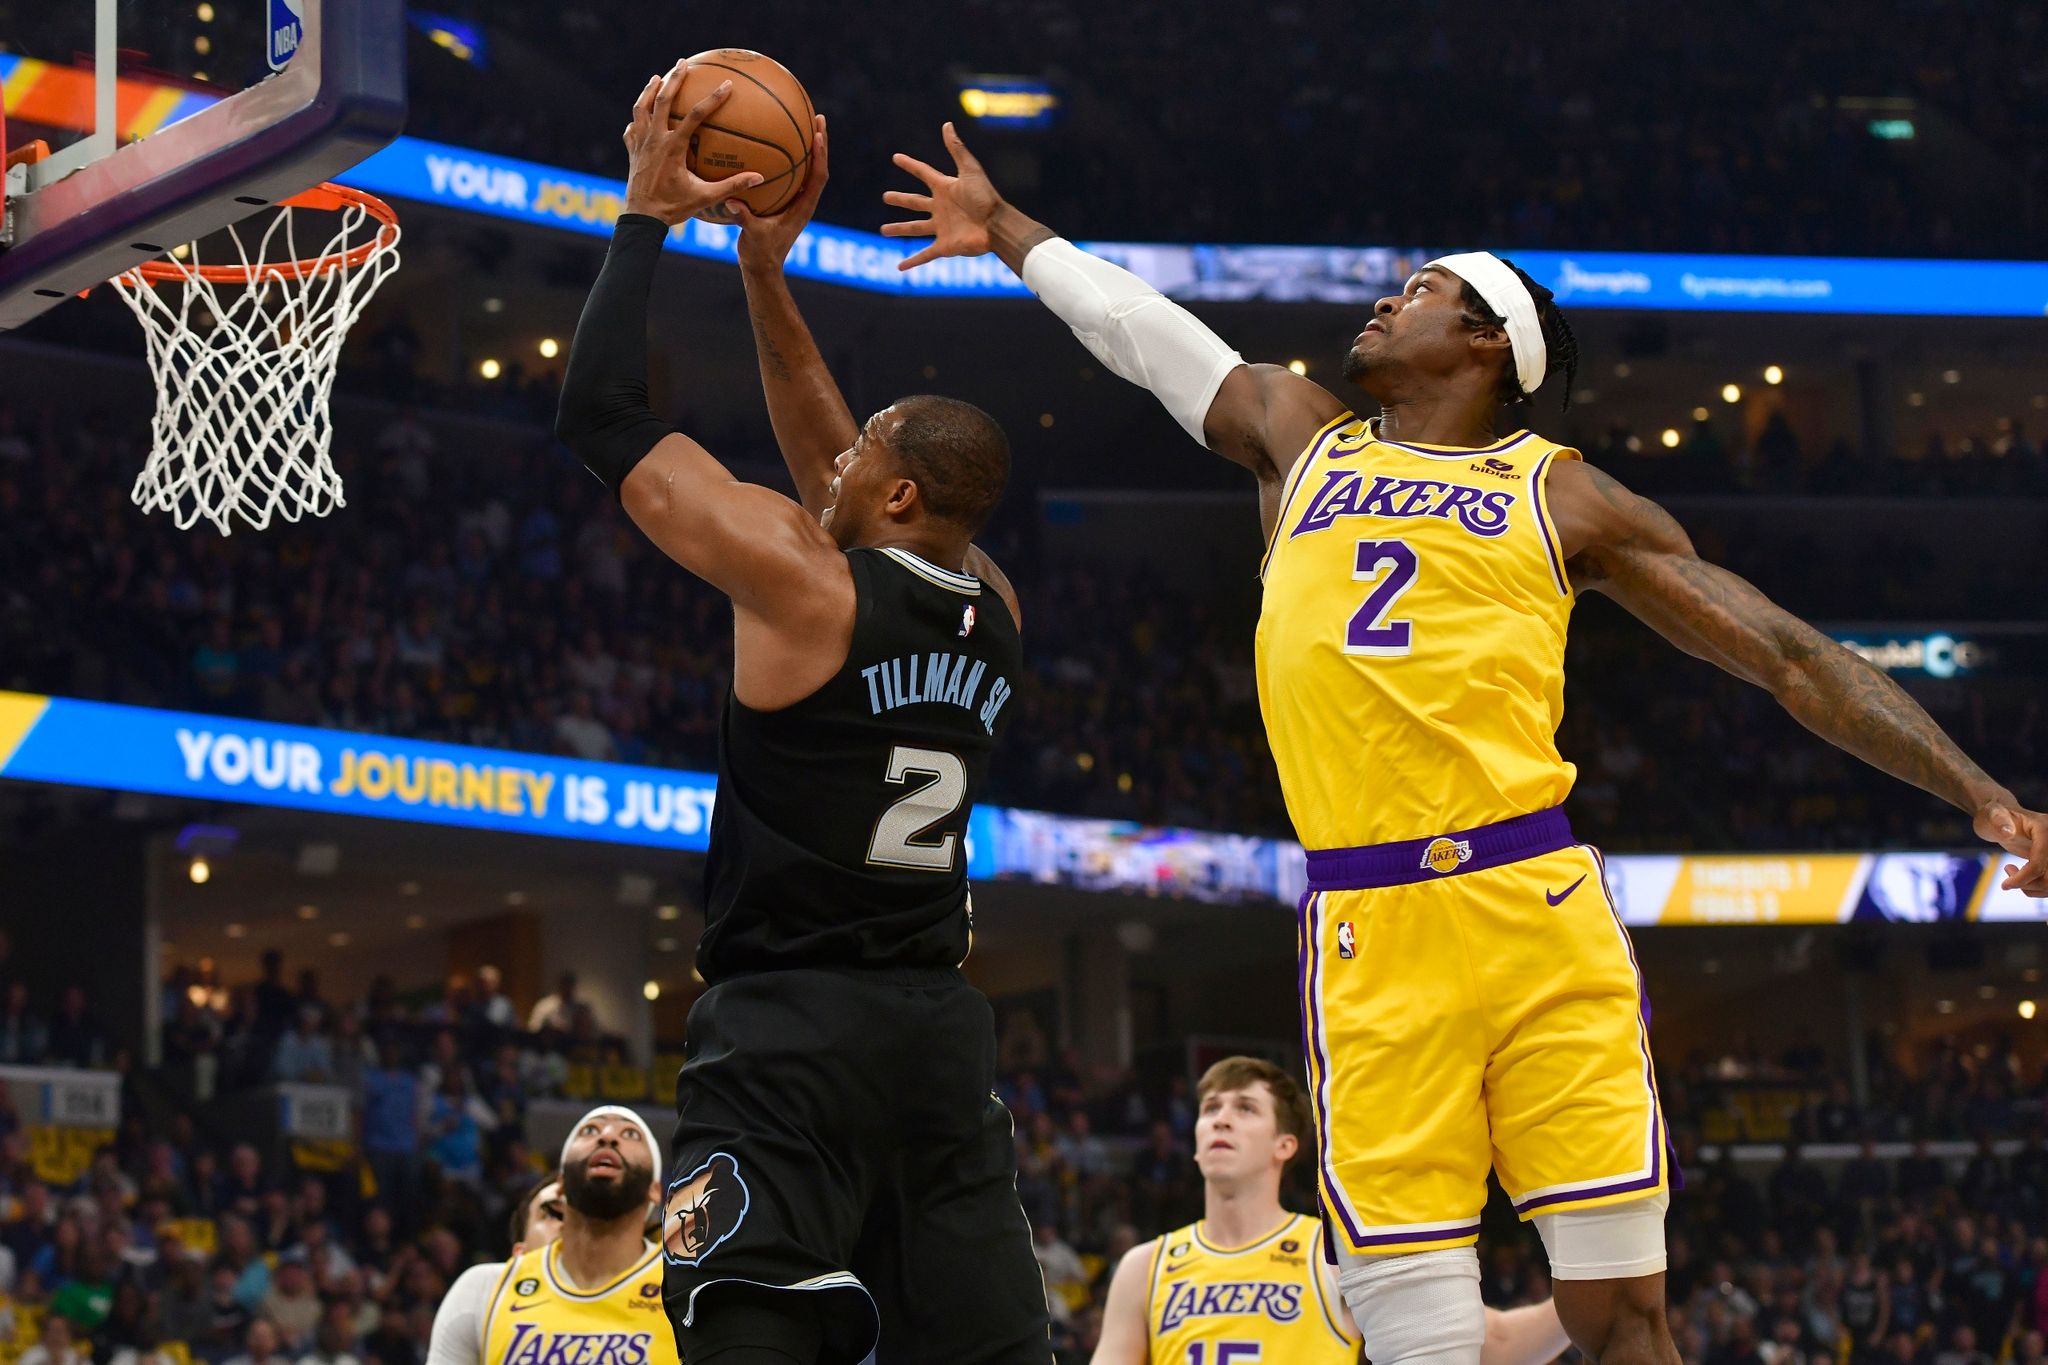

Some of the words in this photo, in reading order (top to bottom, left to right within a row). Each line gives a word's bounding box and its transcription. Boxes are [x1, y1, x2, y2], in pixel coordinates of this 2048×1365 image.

[275, 22, 298, 57] NBA
[425, 154, 528, 210] YOUR
[1470, 464, 1521, 480] bibigo
[1288, 470, 1517, 543] LAKERS
[1343, 538, 1419, 656] 2
[861, 652, 987, 715] TILLMAN
[175, 728, 323, 794] YOUR
[330, 747, 555, 818] JOURNEY
[563, 773, 610, 825] IS
[865, 745, 967, 872] 2
[1420, 846, 1472, 868] LAKERS
[518, 1279, 536, 1296] 6
[1158, 1281, 1303, 1336] LAKERS
[503, 1323, 652, 1365] LAKERS
